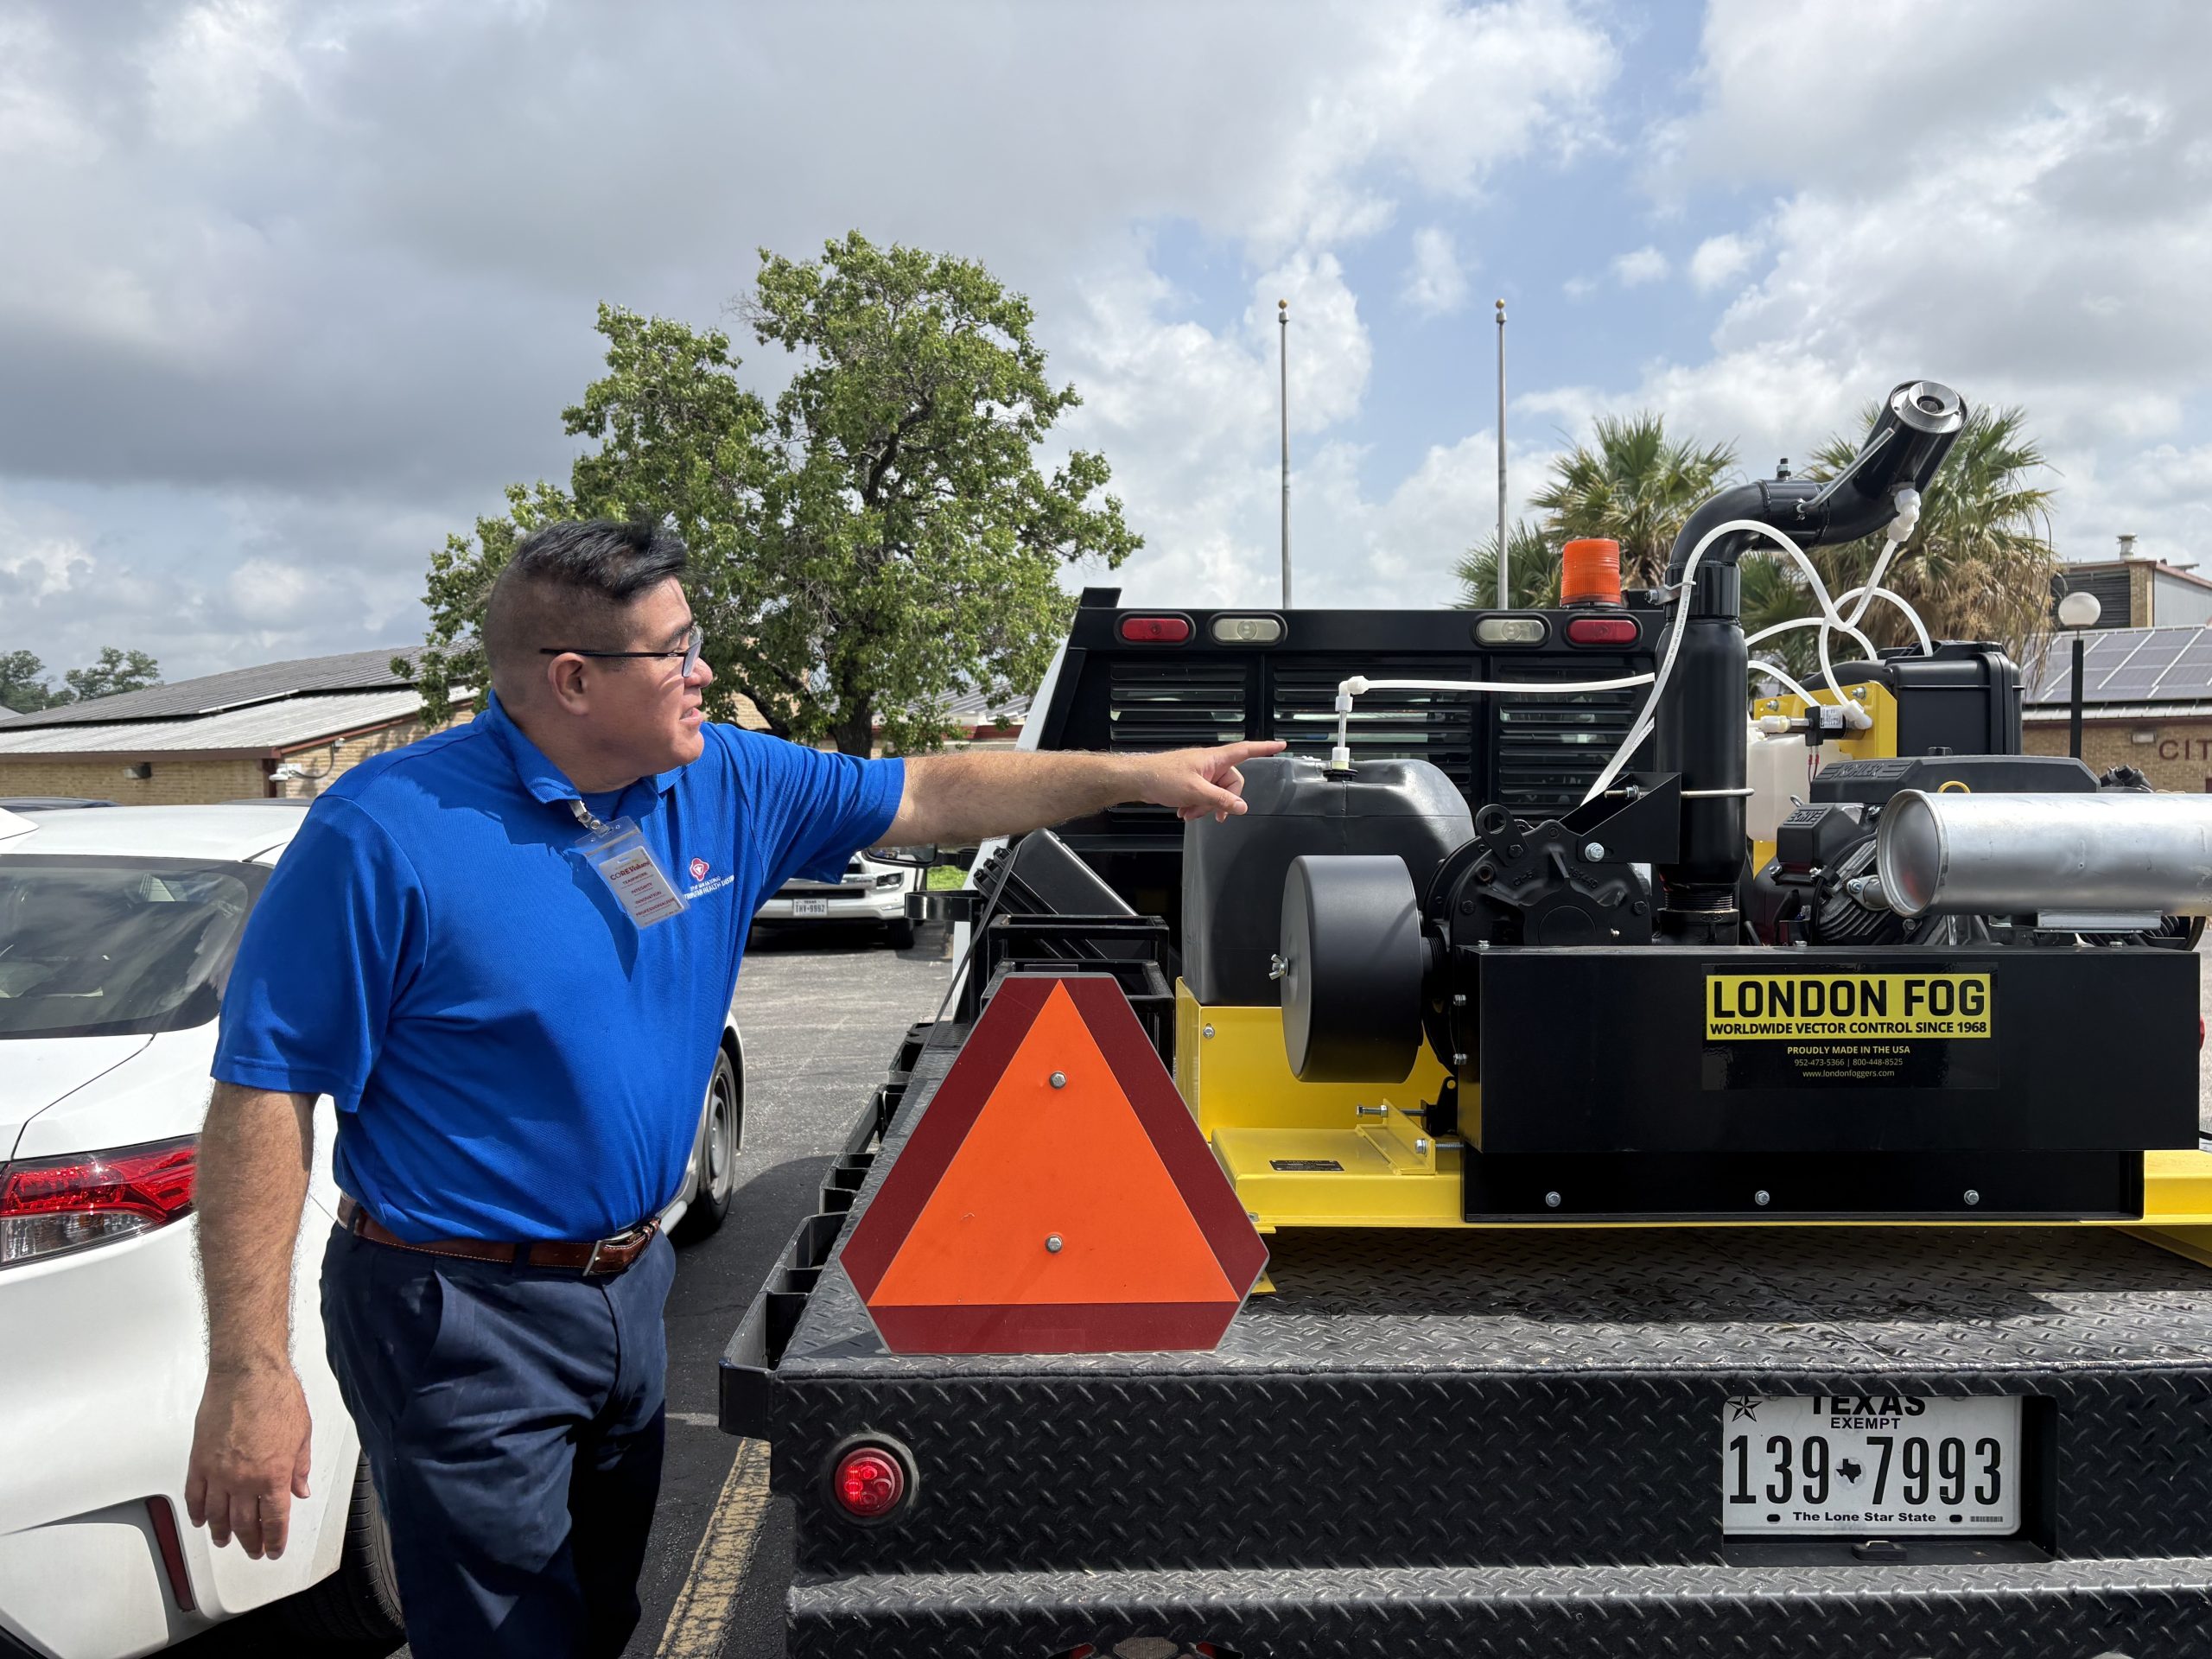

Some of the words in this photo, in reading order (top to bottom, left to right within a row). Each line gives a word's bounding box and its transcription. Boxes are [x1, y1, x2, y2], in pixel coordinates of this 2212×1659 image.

[1713, 980, 1887, 1018] LONDON
[1904, 979, 1985, 1017] FOG
[1710, 1022, 1793, 1035] WORLDWIDE
[1796, 1022, 1847, 1034] VECTOR
[1849, 1021, 1914, 1034] CONTROL
[1916, 1021, 1954, 1033] SINCE
[1957, 1021, 1986, 1033] 1968
[1788, 1046, 1830, 1055] PROUDLY
[1832, 1046, 1859, 1054] MADE
[1860, 1046, 1870, 1054] IN
[1872, 1046, 1890, 1054] THE
[1892, 1046, 1910, 1054] USA
[1795, 1058, 1845, 1067] 952-473-5366
[1802, 1068, 1895, 1078] www.londonfoggers.com
[1830, 1417, 1901, 1430] EXEMPT
[1729, 1434, 1830, 1504] 139
[1866, 1435, 2002, 1505] 7993
[1793, 1511, 1820, 1522] The
[1824, 1511, 1860, 1522] Lone
[1864, 1511, 1895, 1522] Star
[1898, 1511, 1936, 1522] State
